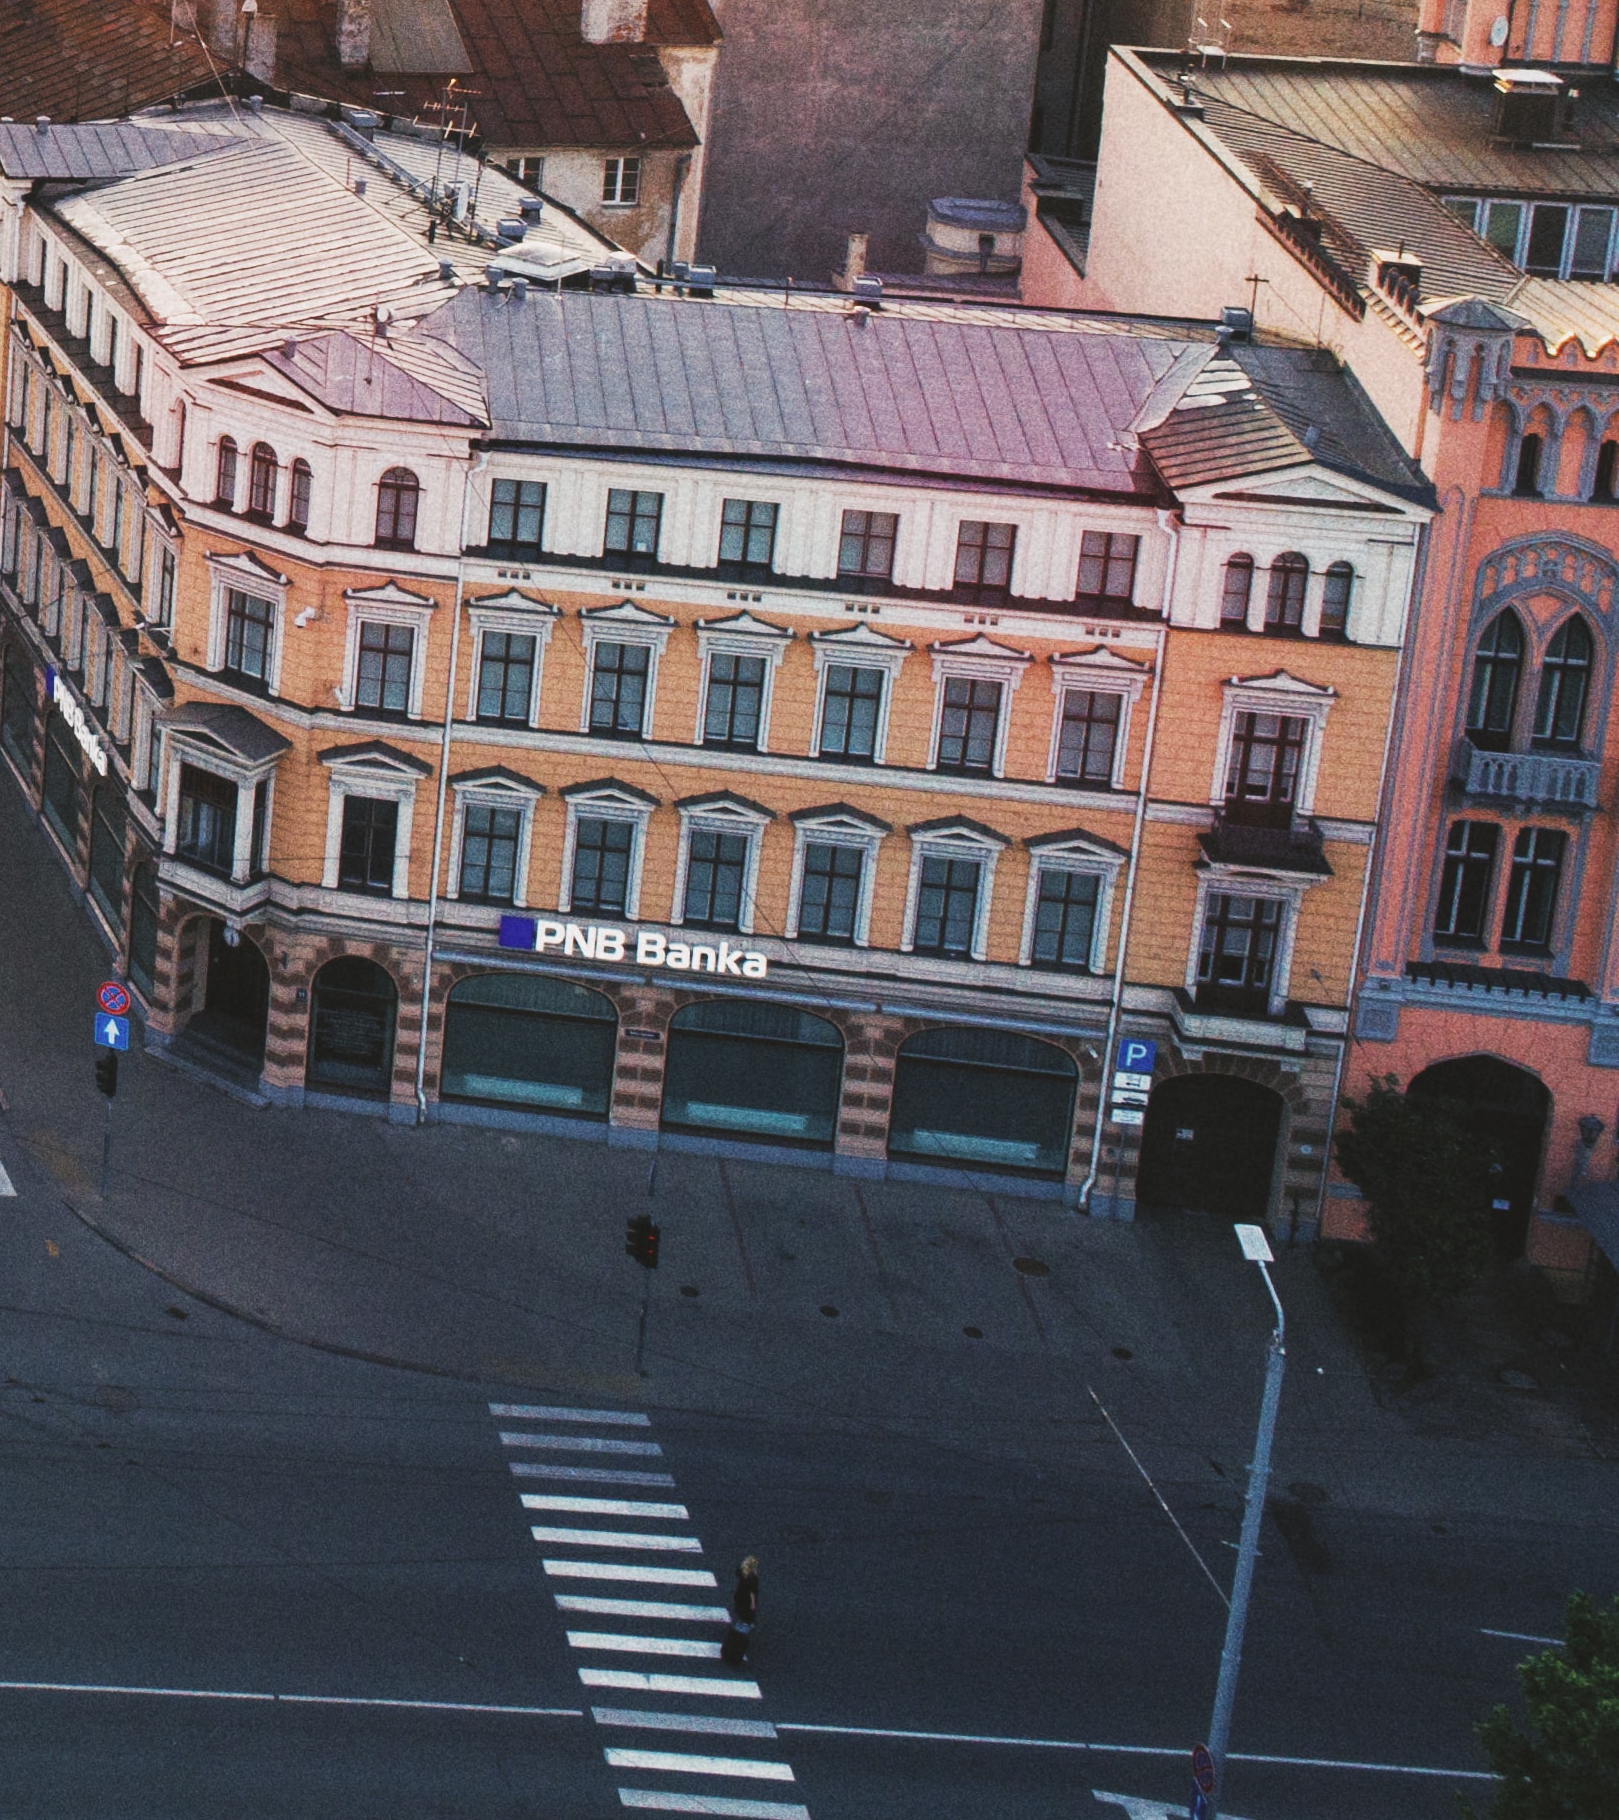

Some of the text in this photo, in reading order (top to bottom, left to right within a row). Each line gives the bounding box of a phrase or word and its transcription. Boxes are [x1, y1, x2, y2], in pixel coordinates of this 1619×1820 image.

[535, 919, 768, 979] PNB Banka
[1126, 1043, 1148, 1067] P
